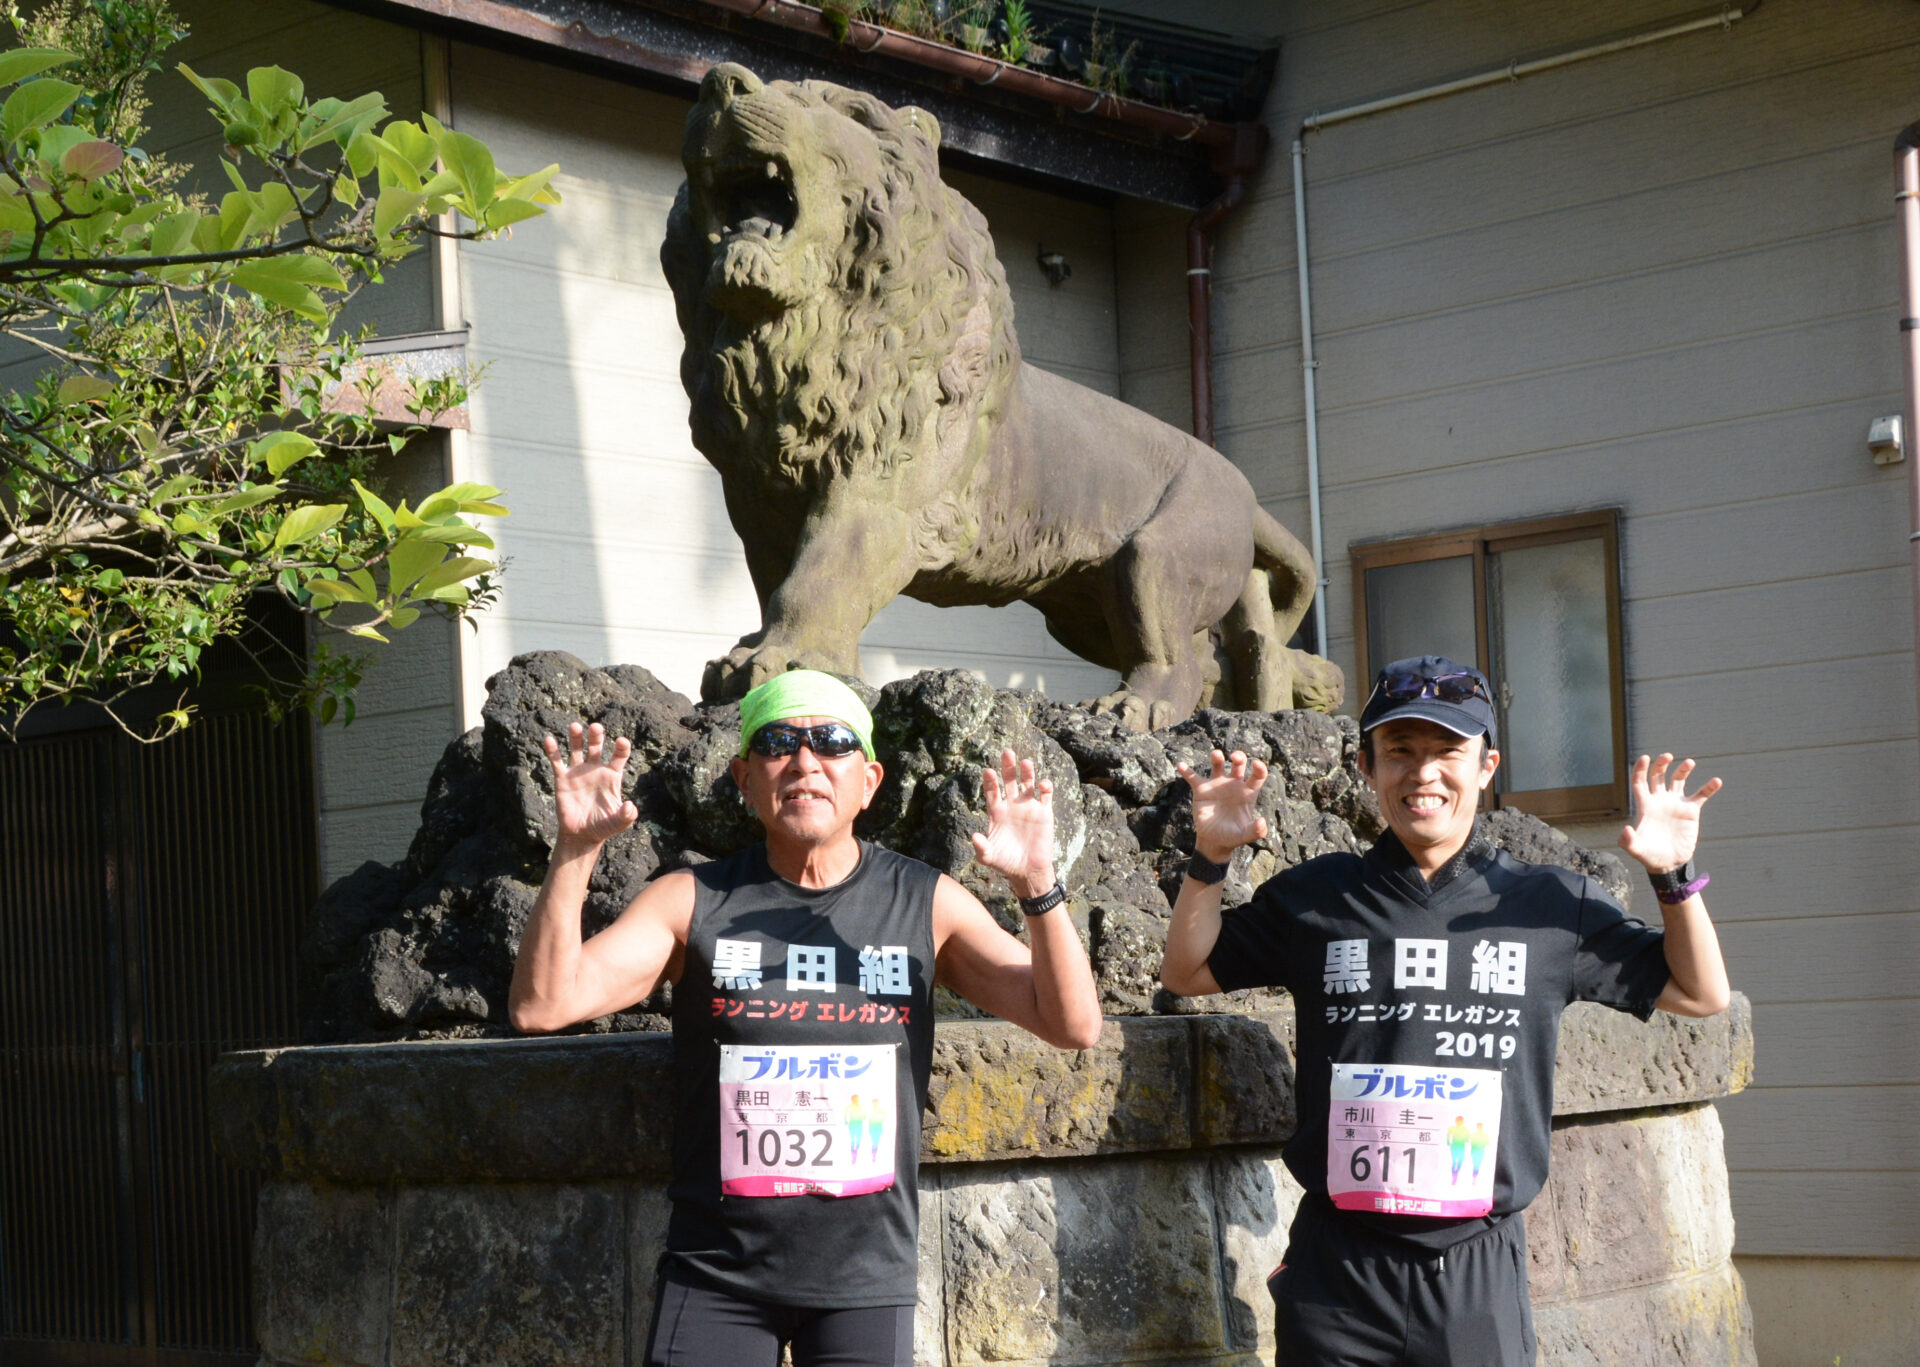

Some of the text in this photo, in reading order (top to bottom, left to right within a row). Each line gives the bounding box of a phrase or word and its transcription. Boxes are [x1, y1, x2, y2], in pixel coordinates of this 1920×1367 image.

[712, 939, 912, 995] 黒田組
[1323, 938, 1527, 996] 黒田組
[711, 998, 911, 1024] ランニング エレガンス
[1325, 1002, 1520, 1027] ランニング エレガンス
[1435, 1031, 1517, 1060] 2019
[743, 1050, 872, 1080] ブルボン
[1353, 1068, 1479, 1100] ブルボン
[736, 1129, 834, 1167] 1032
[1350, 1145, 1416, 1184] 611
